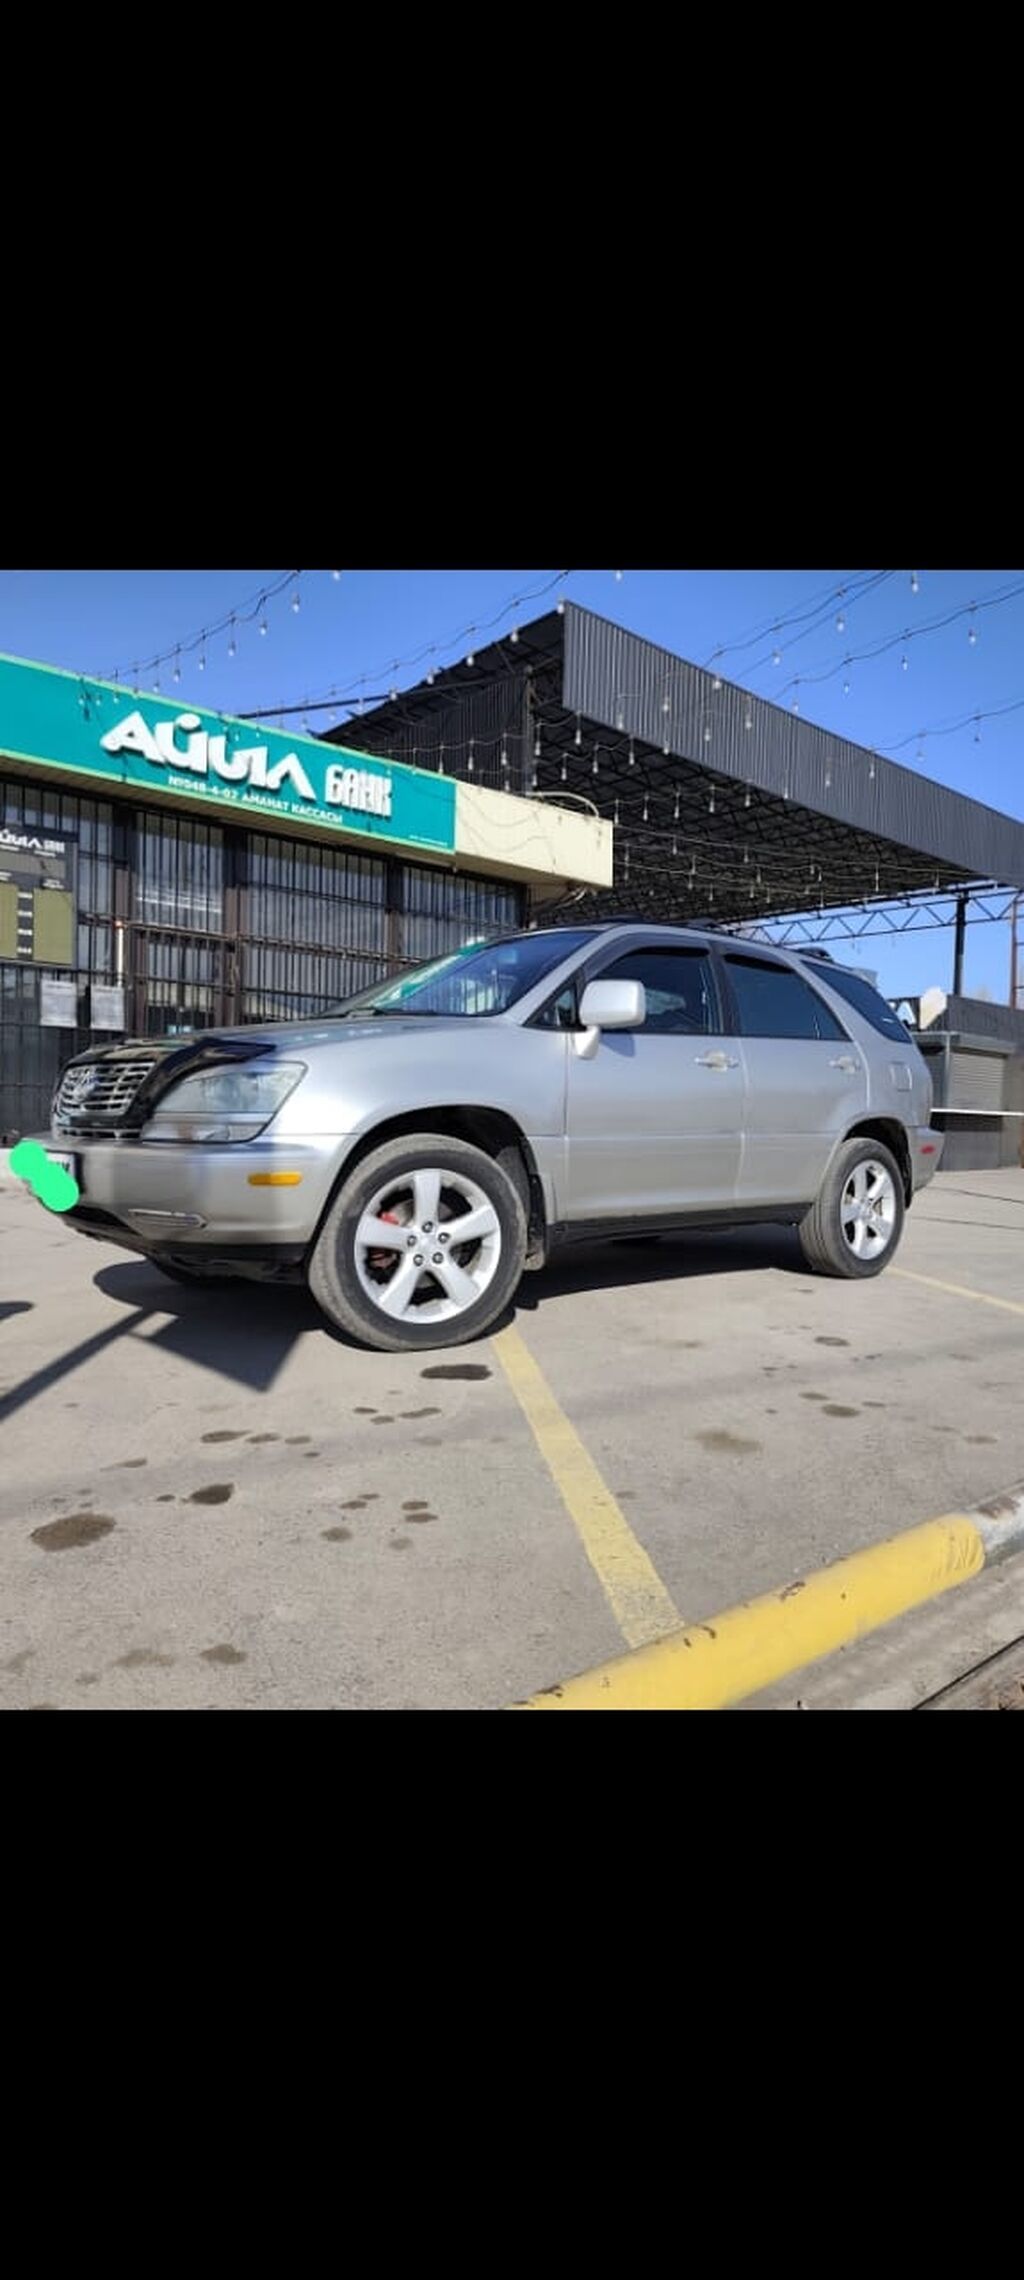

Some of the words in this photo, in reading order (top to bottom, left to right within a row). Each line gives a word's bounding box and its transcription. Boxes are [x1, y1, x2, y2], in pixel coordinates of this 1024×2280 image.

[242, 792, 289, 811] АМАНАТ
[291, 802, 343, 823] КАССАСЫ
[325, 764, 392, 817] БАНК
